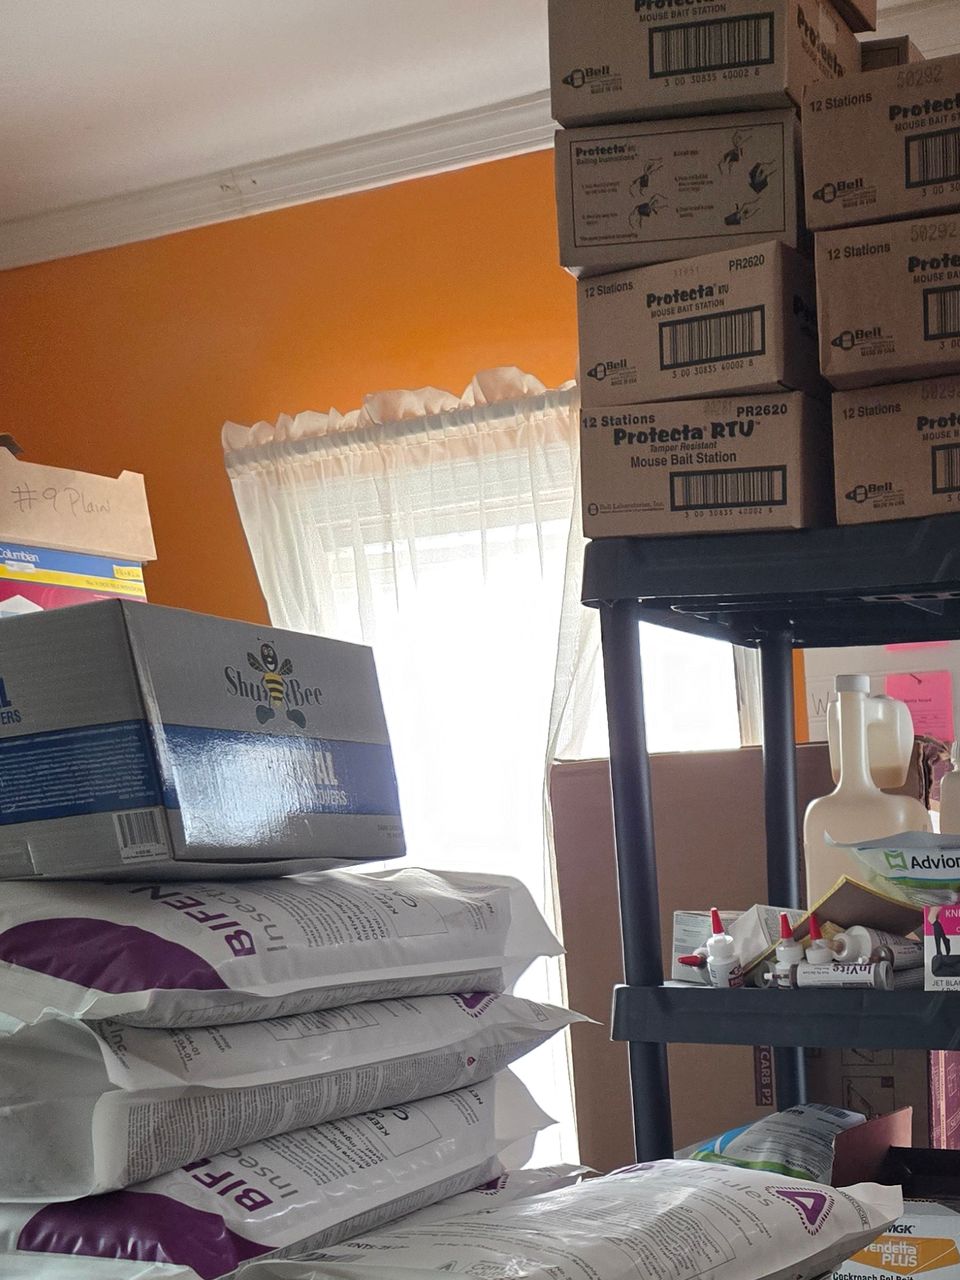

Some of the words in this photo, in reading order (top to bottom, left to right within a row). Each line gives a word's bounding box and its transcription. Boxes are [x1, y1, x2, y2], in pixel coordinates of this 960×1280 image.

[639, 13, 669, 22] MOUSE
[671, 10, 690, 18] BAIT
[692, 4, 726, 16] STATION
[585, 66, 610, 77] Bell
[722, 70, 749, 80] 40002
[810, 102, 822, 112] 12
[825, 93, 873, 110] Stations
[895, 118, 927, 132] MOUSE
[929, 116, 948, 127] BAIT
[576, 145, 625, 157] Protecta
[837, 178, 863, 191] Bell
[911, 223, 957, 243] 50292
[827, 249, 840, 260] 12
[844, 243, 890, 258] Stations
[729, 255, 765, 271] PR2620
[913, 273, 944, 284] MOUSE
[585, 287, 595, 298] 12
[597, 281, 633, 296] Stations
[647, 285, 714, 308] Protecta
[651, 307, 675, 318] MOUSE
[677, 304, 693, 314] BAIT
[695, 299, 725, 311] STATION
[855, 327, 882, 340] Bell
[607, 359, 627, 370] Bell
[721, 362, 744, 371] 40002
[737, 404, 788, 416] PR2620
[843, 409, 855, 420] 12
[858, 403, 901, 417] Stations
[583, 417, 597, 428] 12
[601, 414, 656, 427] Stations
[614, 425, 703, 446] Protecta
[711, 421, 754, 439] RTU
[923, 430, 951, 441] MOUSE
[650, 444, 678, 453] Tamper
[680, 441, 718, 451] Resistant
[631, 455, 668, 468] Mouse
[671, 453, 693, 466] Bait
[696, 451, 737, 464] Station
[868, 482, 893, 493] Bell
[224, 666, 262, 702] Shu
[291, 678, 323, 706] Bee
[760, 1052, 771, 1085] CARB
[762, 1088, 771, 1105] P2
[882, 1254, 918, 1267] PLUS
